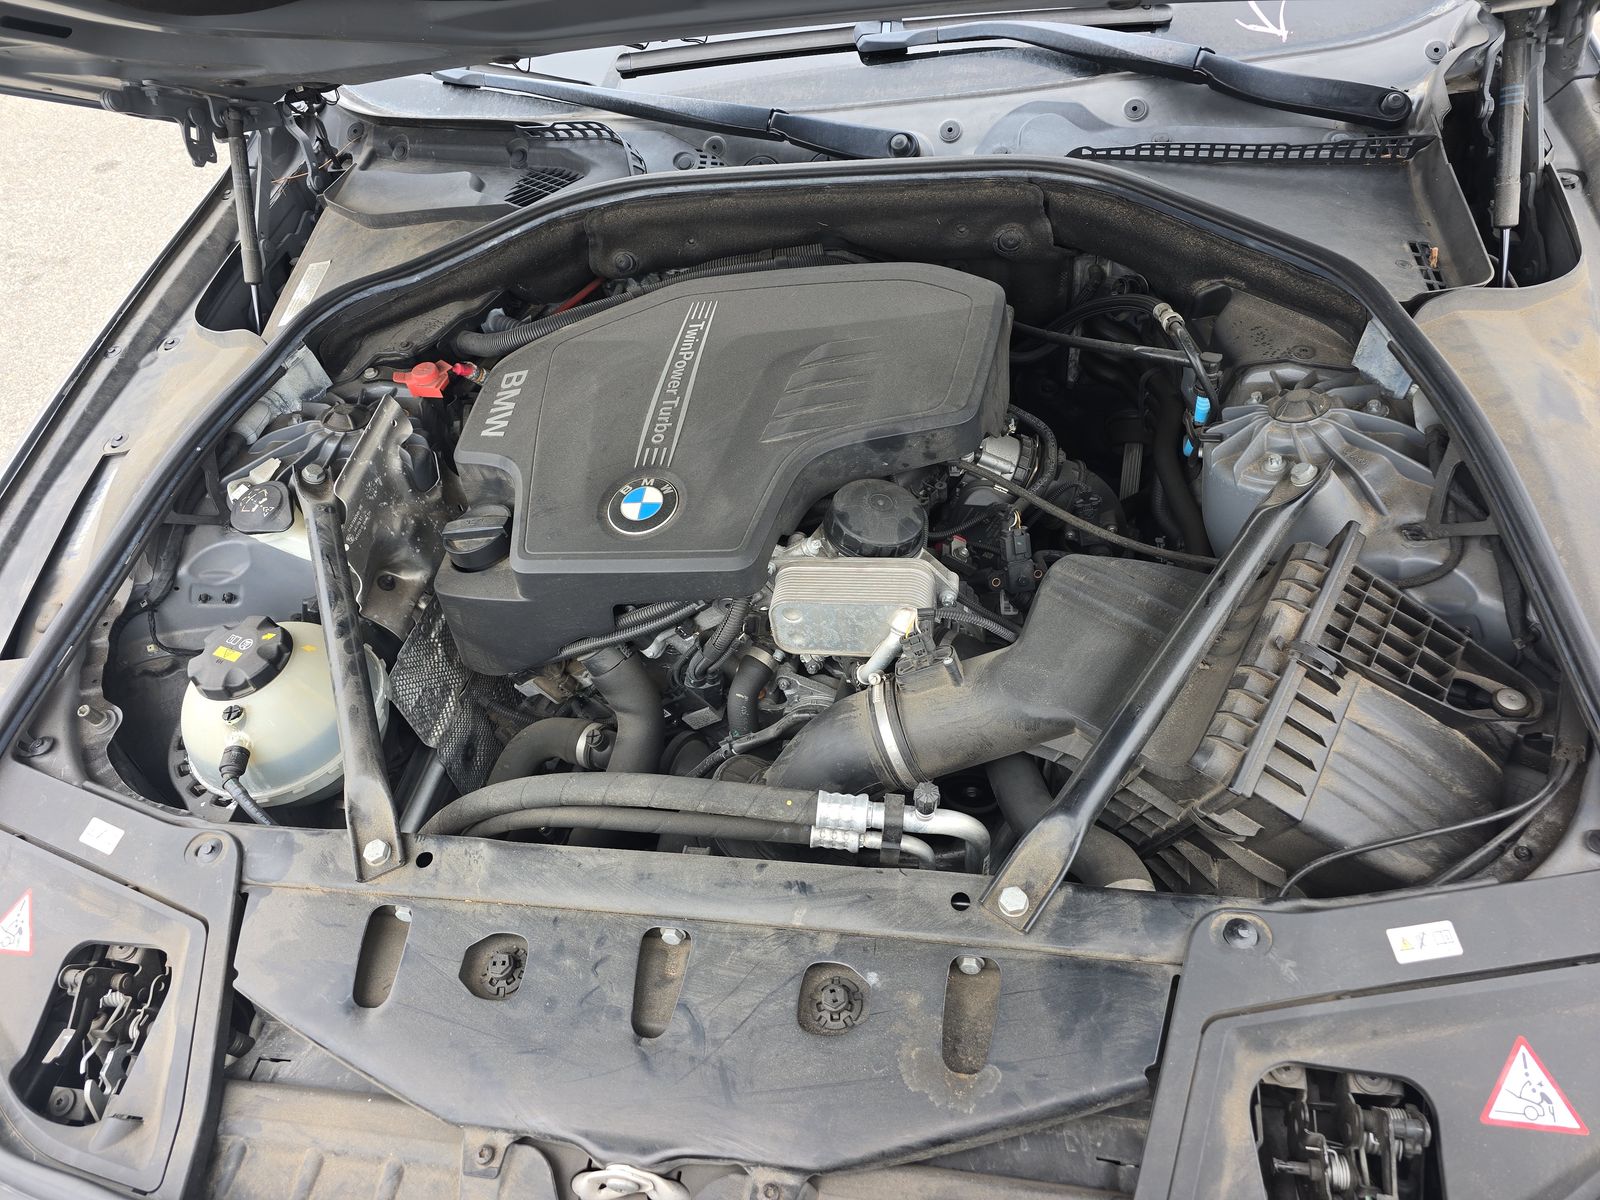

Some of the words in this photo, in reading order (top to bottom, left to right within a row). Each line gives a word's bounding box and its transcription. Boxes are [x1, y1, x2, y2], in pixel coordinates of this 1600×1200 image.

[666, 321, 705, 395] TwinPower
[481, 370, 529, 437] BMW
[651, 396, 680, 443] Turbo
[620, 478, 674, 495] BMW
